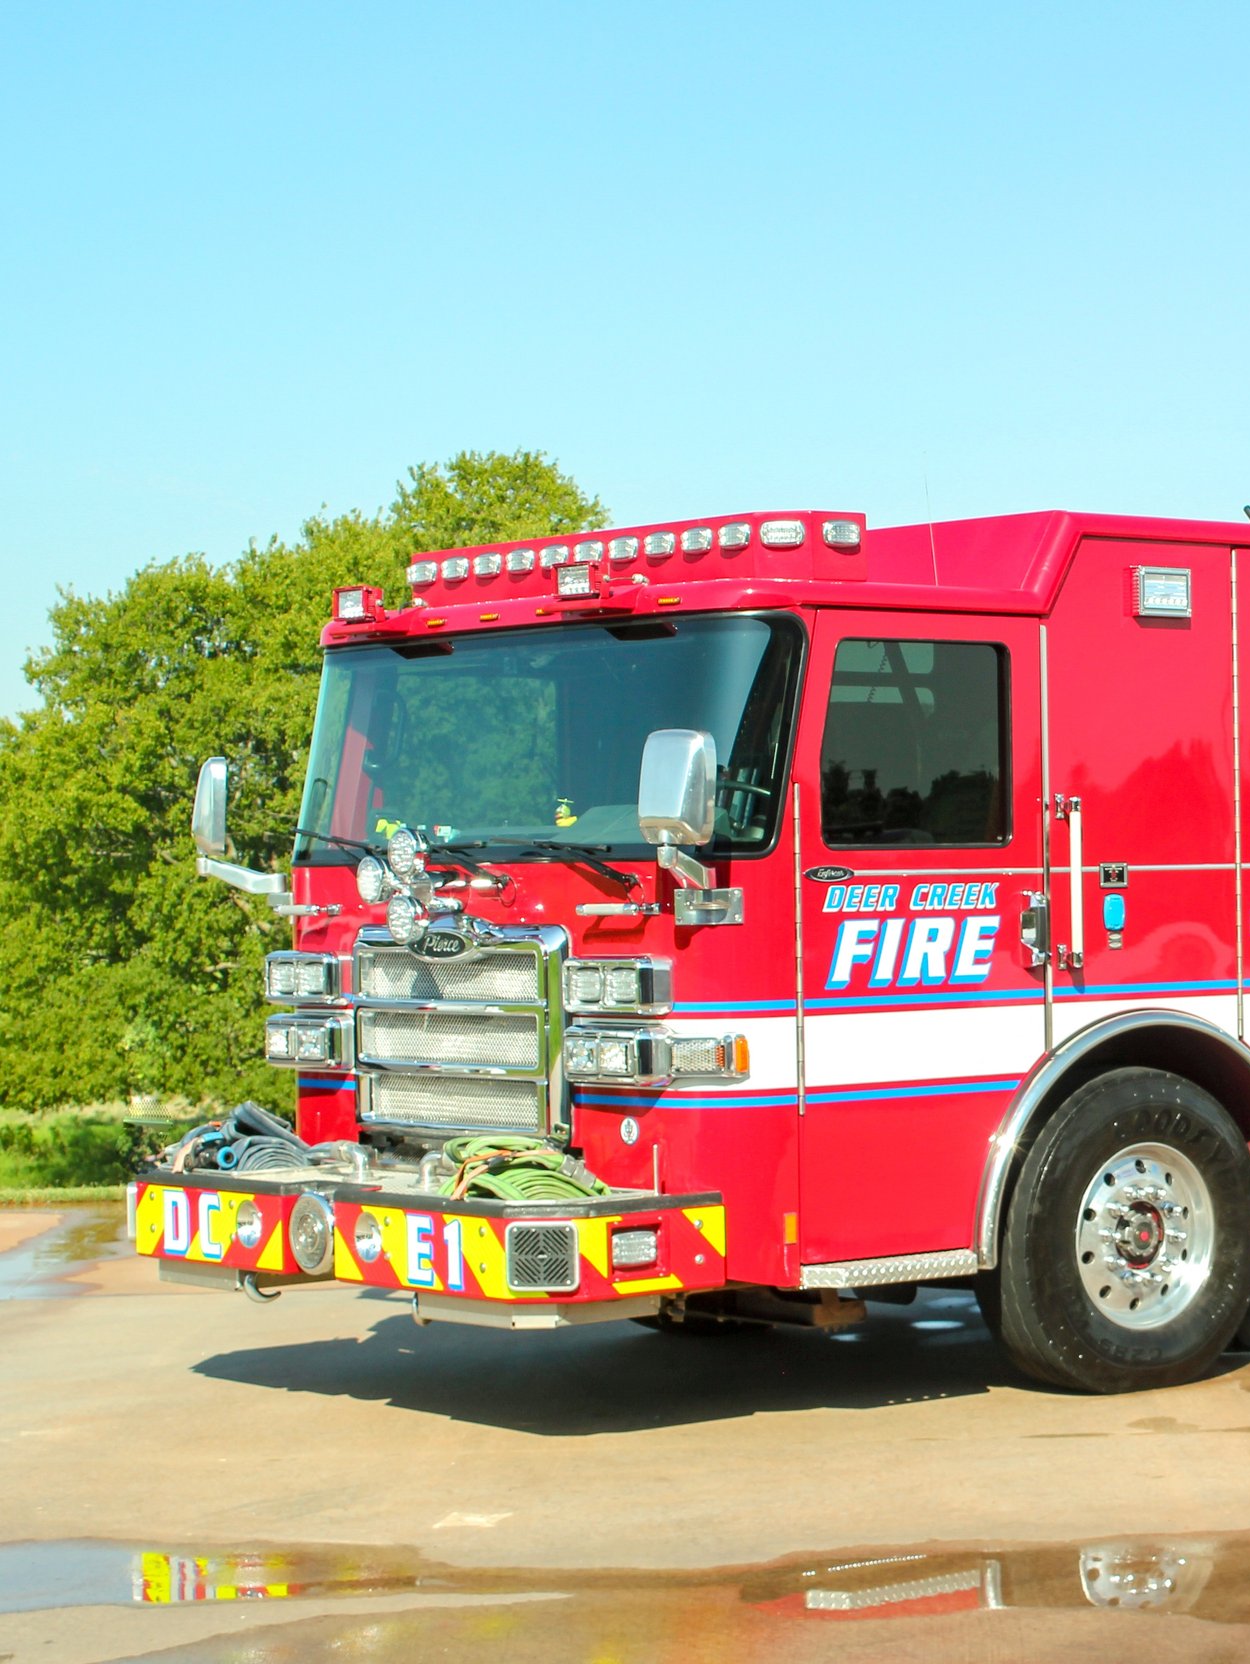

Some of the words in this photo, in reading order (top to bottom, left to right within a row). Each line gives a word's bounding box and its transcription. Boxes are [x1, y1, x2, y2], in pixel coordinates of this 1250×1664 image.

[822, 884, 900, 913] DEER
[909, 882, 1000, 911] CREEK
[422, 933, 460, 955] Pierce
[824, 915, 1000, 991] FIRE
[405, 1213, 465, 1291] E1
